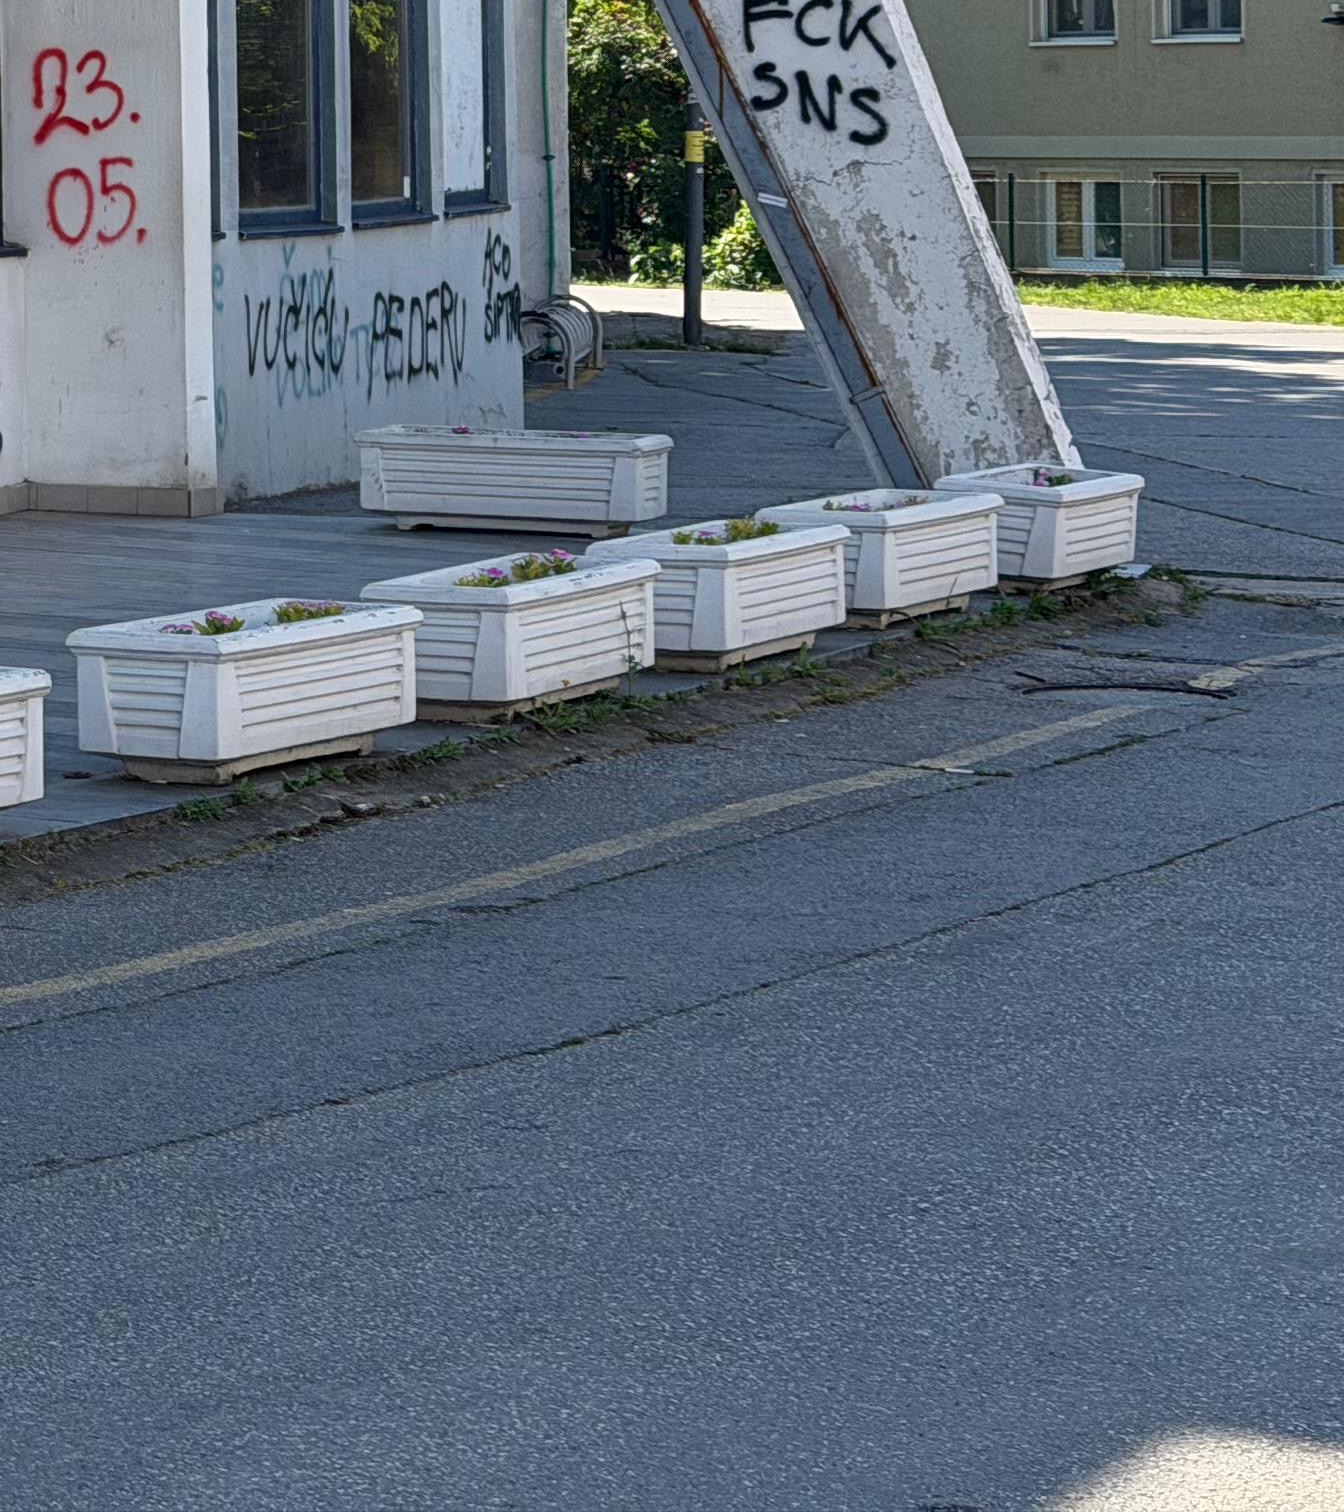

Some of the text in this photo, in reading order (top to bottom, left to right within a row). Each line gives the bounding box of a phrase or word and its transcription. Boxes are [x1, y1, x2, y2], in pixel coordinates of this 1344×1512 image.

[31, 47, 142, 146] 23.
[750, 61, 890, 146] SNS
[46, 156, 148, 246] 05.
[367, 280, 467, 404] PEDERU
